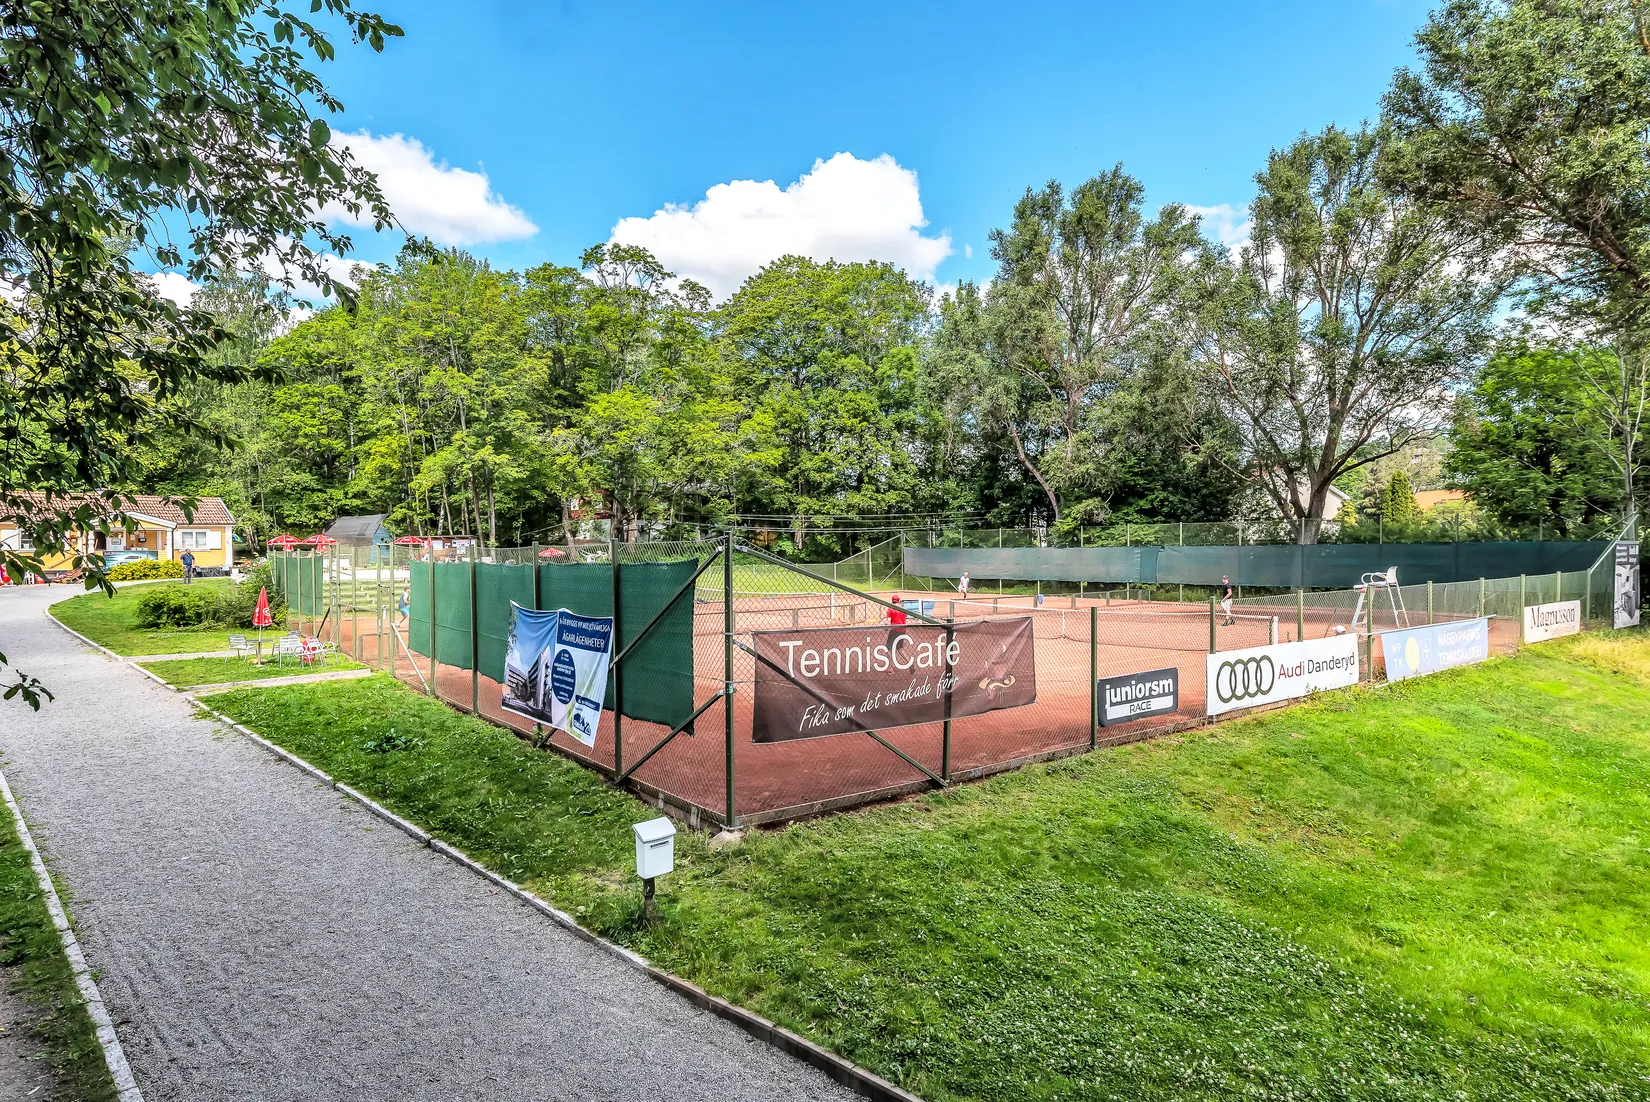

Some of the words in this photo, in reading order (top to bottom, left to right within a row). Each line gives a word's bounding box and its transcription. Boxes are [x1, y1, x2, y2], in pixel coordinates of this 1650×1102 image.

[1530, 606, 1576, 632] Magnusson
[779, 632, 960, 679] TennisCafé
[1278, 661, 1306, 680] Audi
[1307, 652, 1355, 675] Danderyd
[798, 703, 830, 732] Fika
[834, 704, 856, 722] som
[860, 692, 881, 713] det
[885, 679, 932, 706] smakade
[935, 672, 961, 699] förr
[1104, 678, 1174, 710] juniorsm
[1129, 700, 1152, 714] RACE
